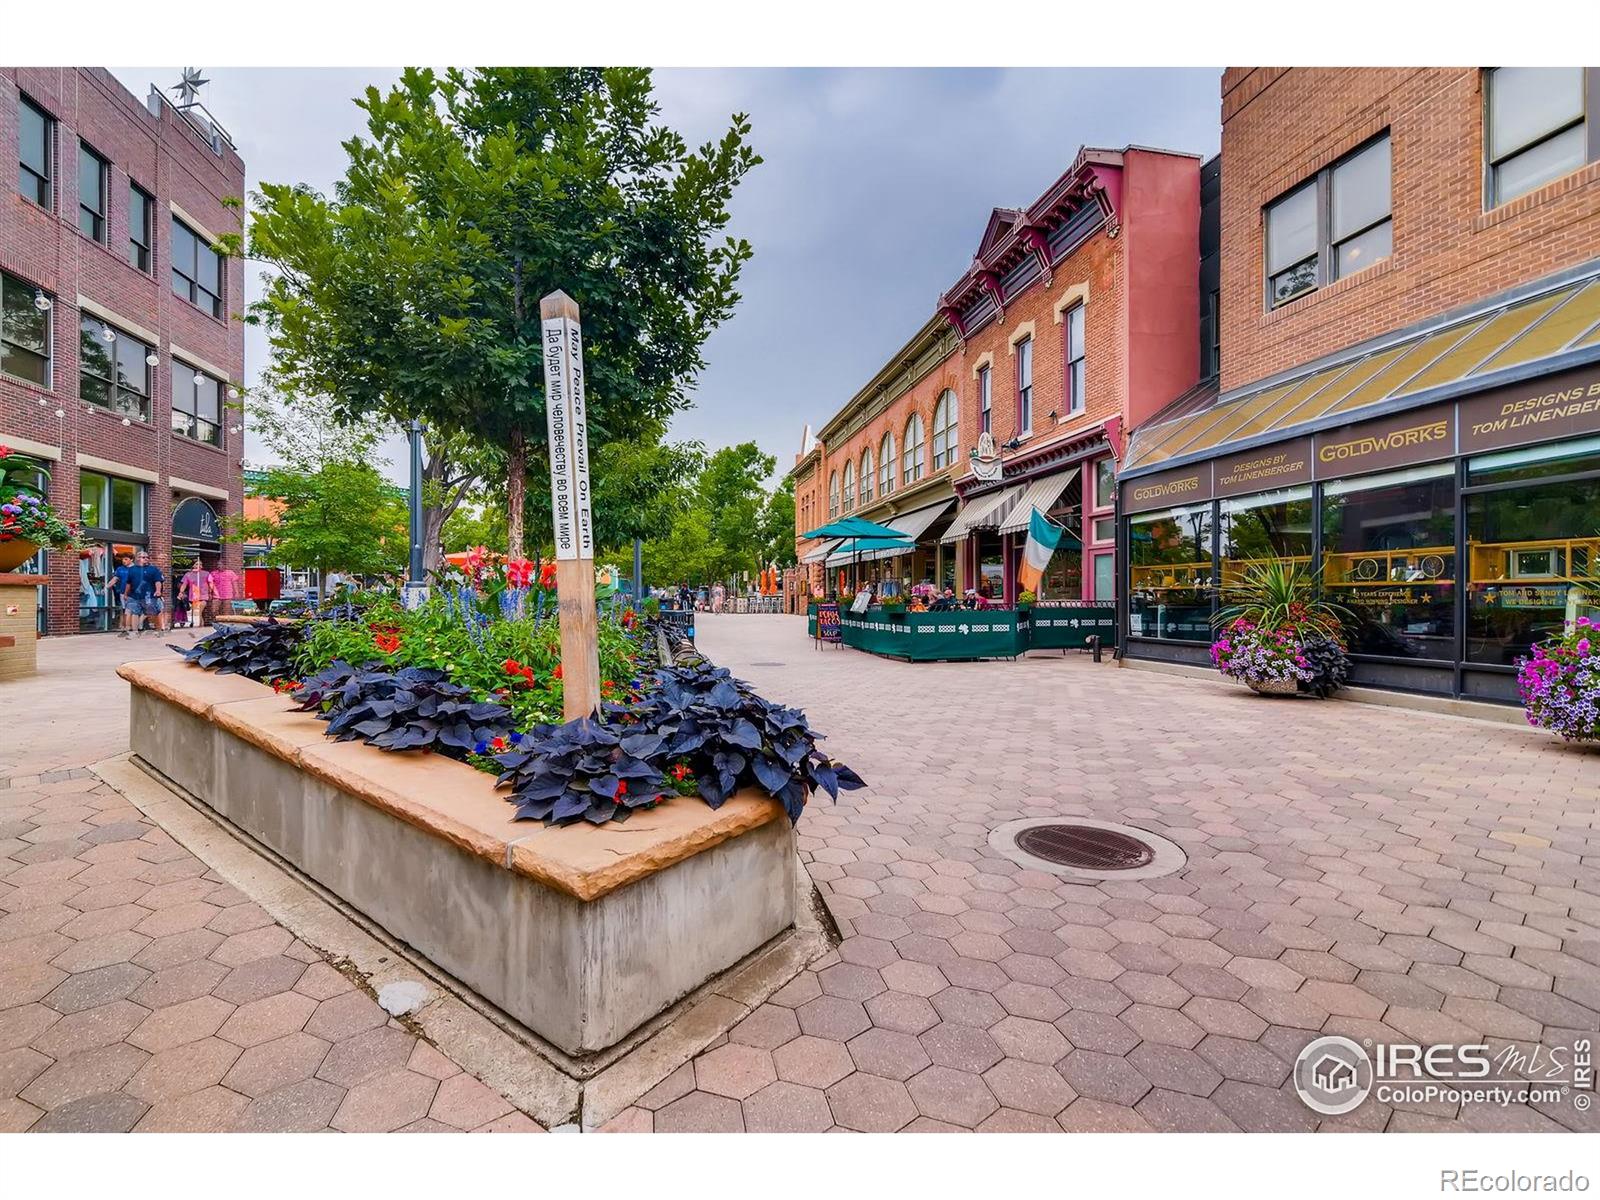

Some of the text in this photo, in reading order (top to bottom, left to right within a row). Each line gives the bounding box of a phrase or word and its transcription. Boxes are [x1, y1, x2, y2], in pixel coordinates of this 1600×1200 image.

[1501, 387, 1584, 416] DESIGNS
[545, 329, 571, 550] Да будет мир человечеству во всем мире
[570, 328, 591, 549] May Peace Prevail On Earth
[1319, 420, 1448, 462] GOLDWORKS
[1471, 419, 1506, 436] TOM
[1219, 460, 1304, 486] TOM LINENBERGER
[1233, 454, 1287, 473] DESIGNS BY
[1133, 476, 1199, 501] GOLDWORKS
